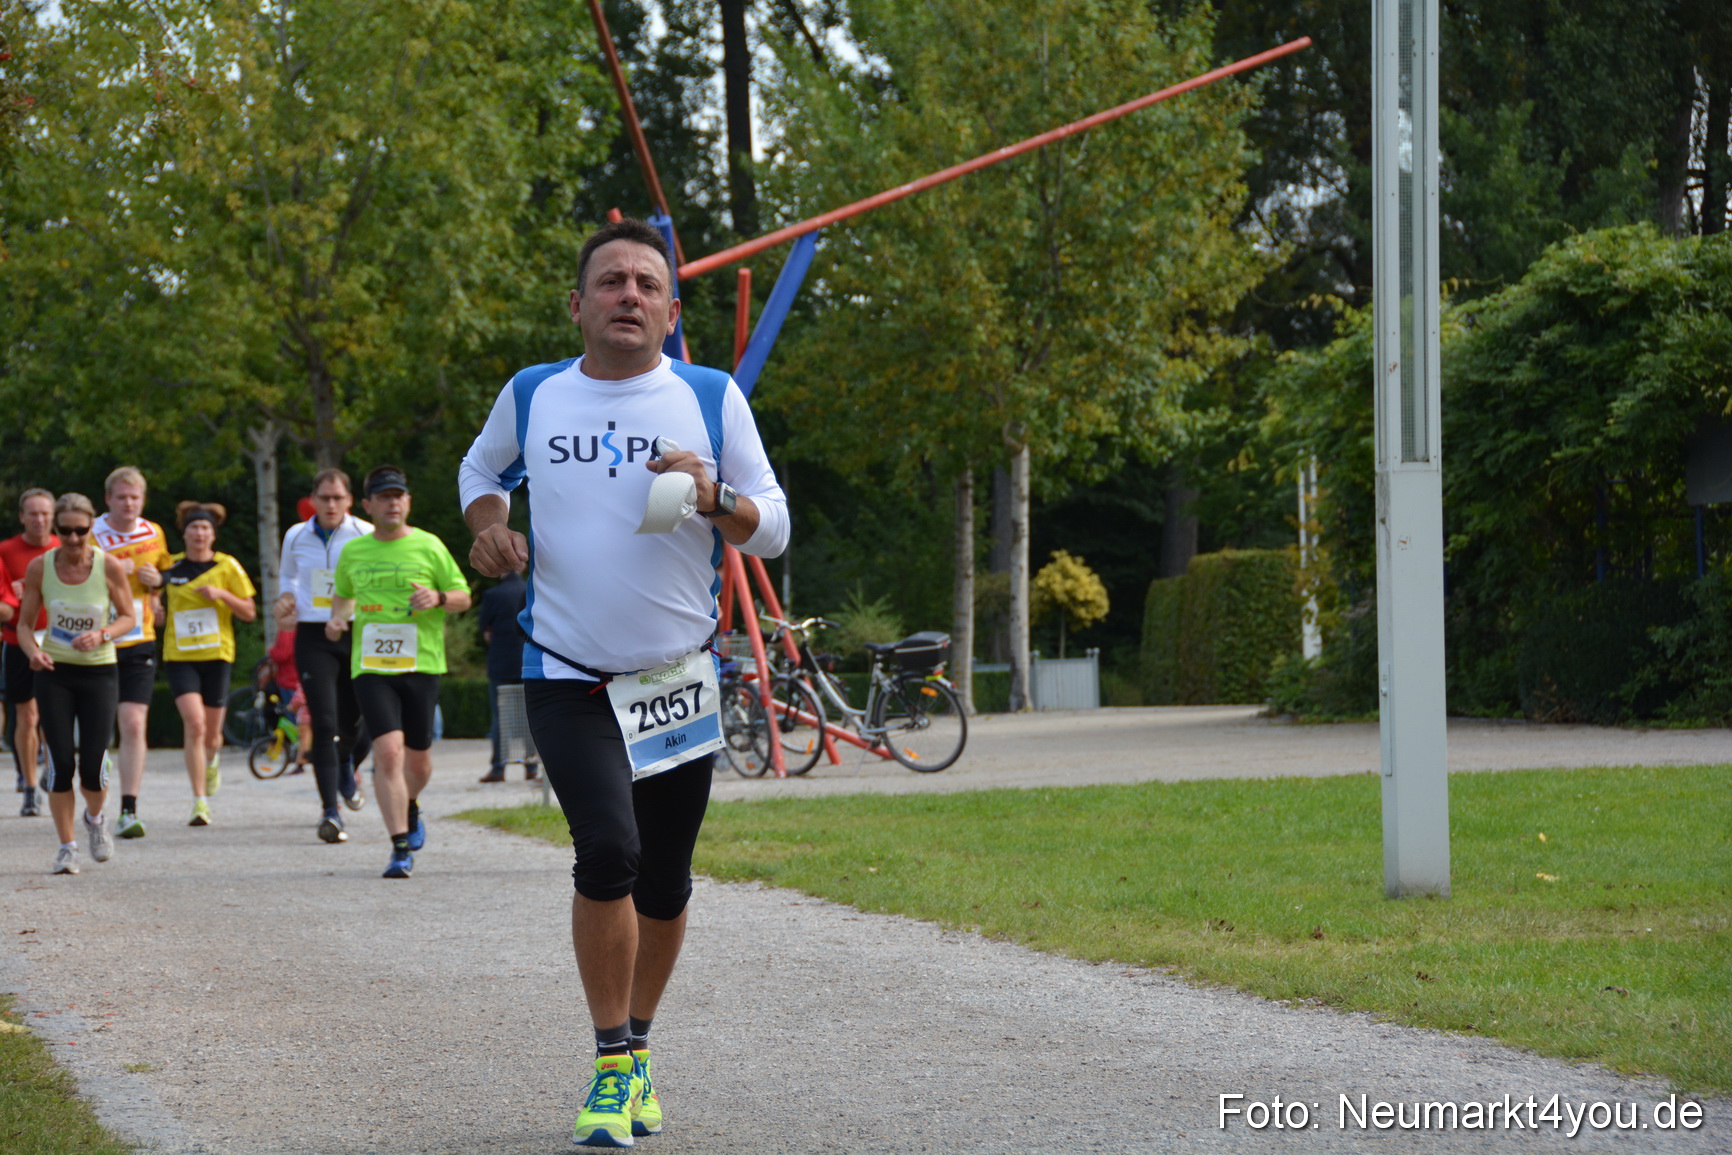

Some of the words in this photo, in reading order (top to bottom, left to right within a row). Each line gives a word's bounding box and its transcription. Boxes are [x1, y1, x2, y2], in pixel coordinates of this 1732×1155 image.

[57, 614, 94, 631] 2099
[188, 621, 203, 634] 51
[375, 639, 404, 654] 237
[629, 681, 704, 733] 2057
[665, 733, 687, 749] Akin
